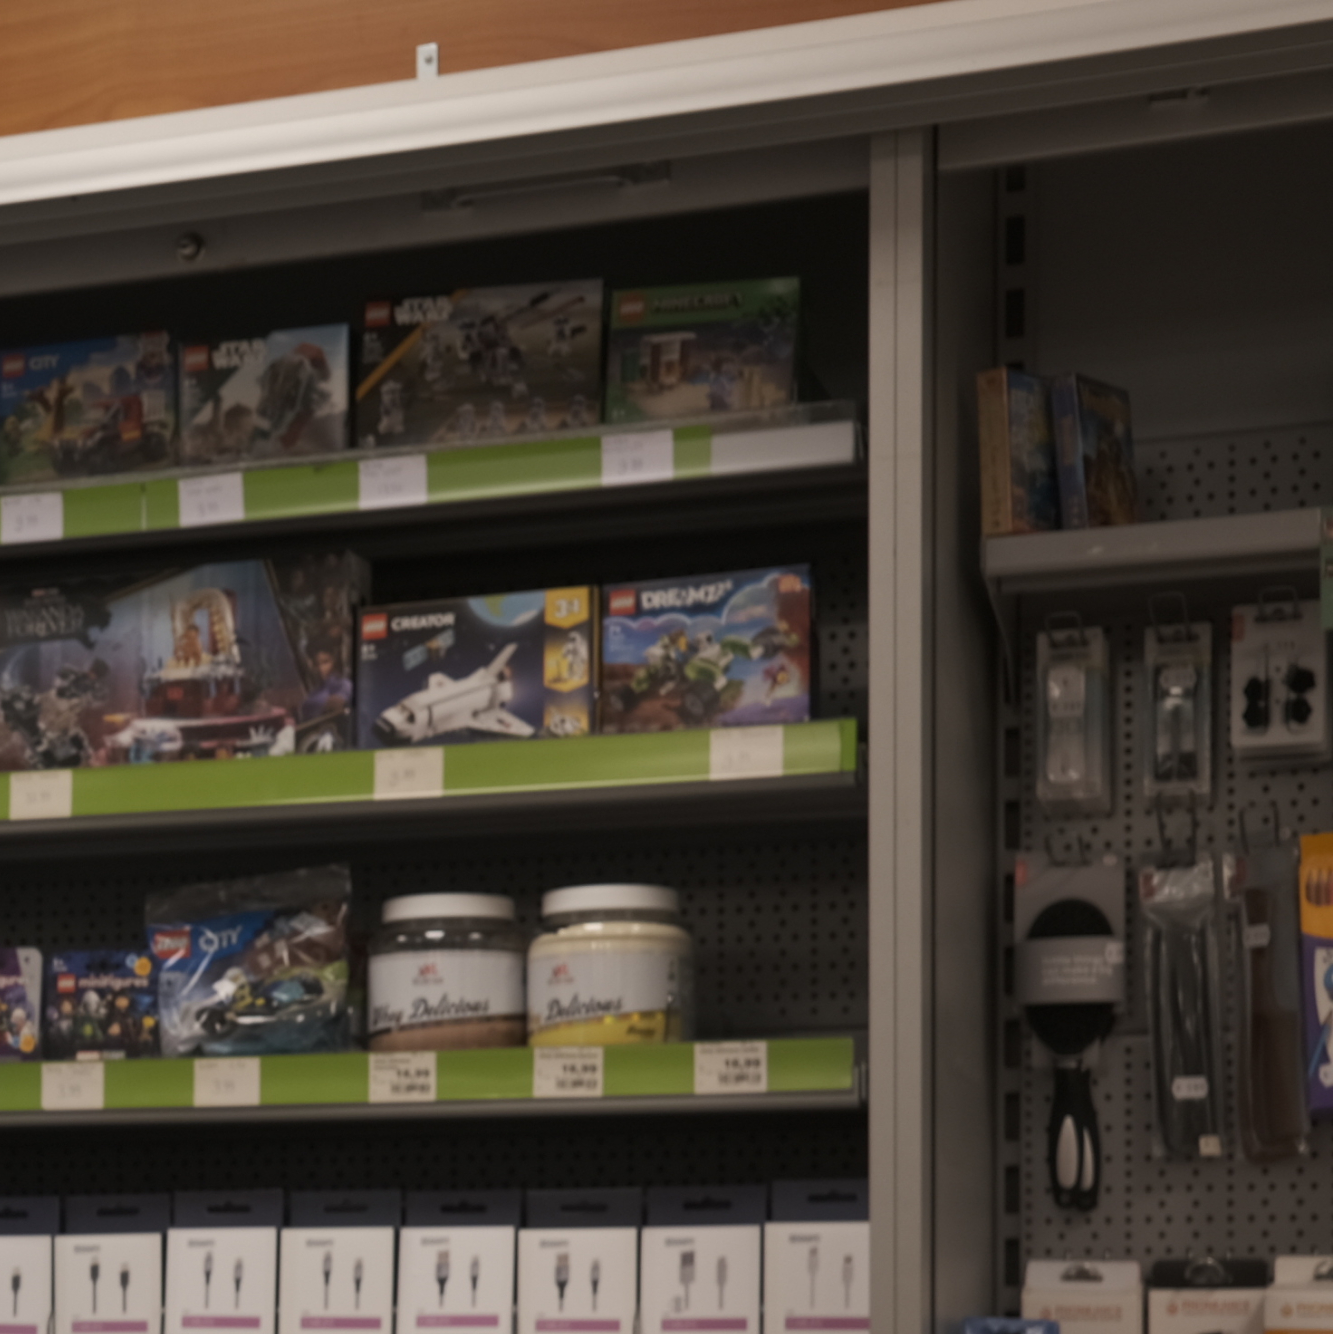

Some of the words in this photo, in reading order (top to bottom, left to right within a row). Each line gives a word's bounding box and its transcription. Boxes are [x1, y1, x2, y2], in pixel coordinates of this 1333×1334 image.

[29, 354, 60, 370] CITY
[390, 612, 456, 632] CREATOR
[409, 991, 490, 1021] Delicious
[545, 991, 623, 1021] Delicious
